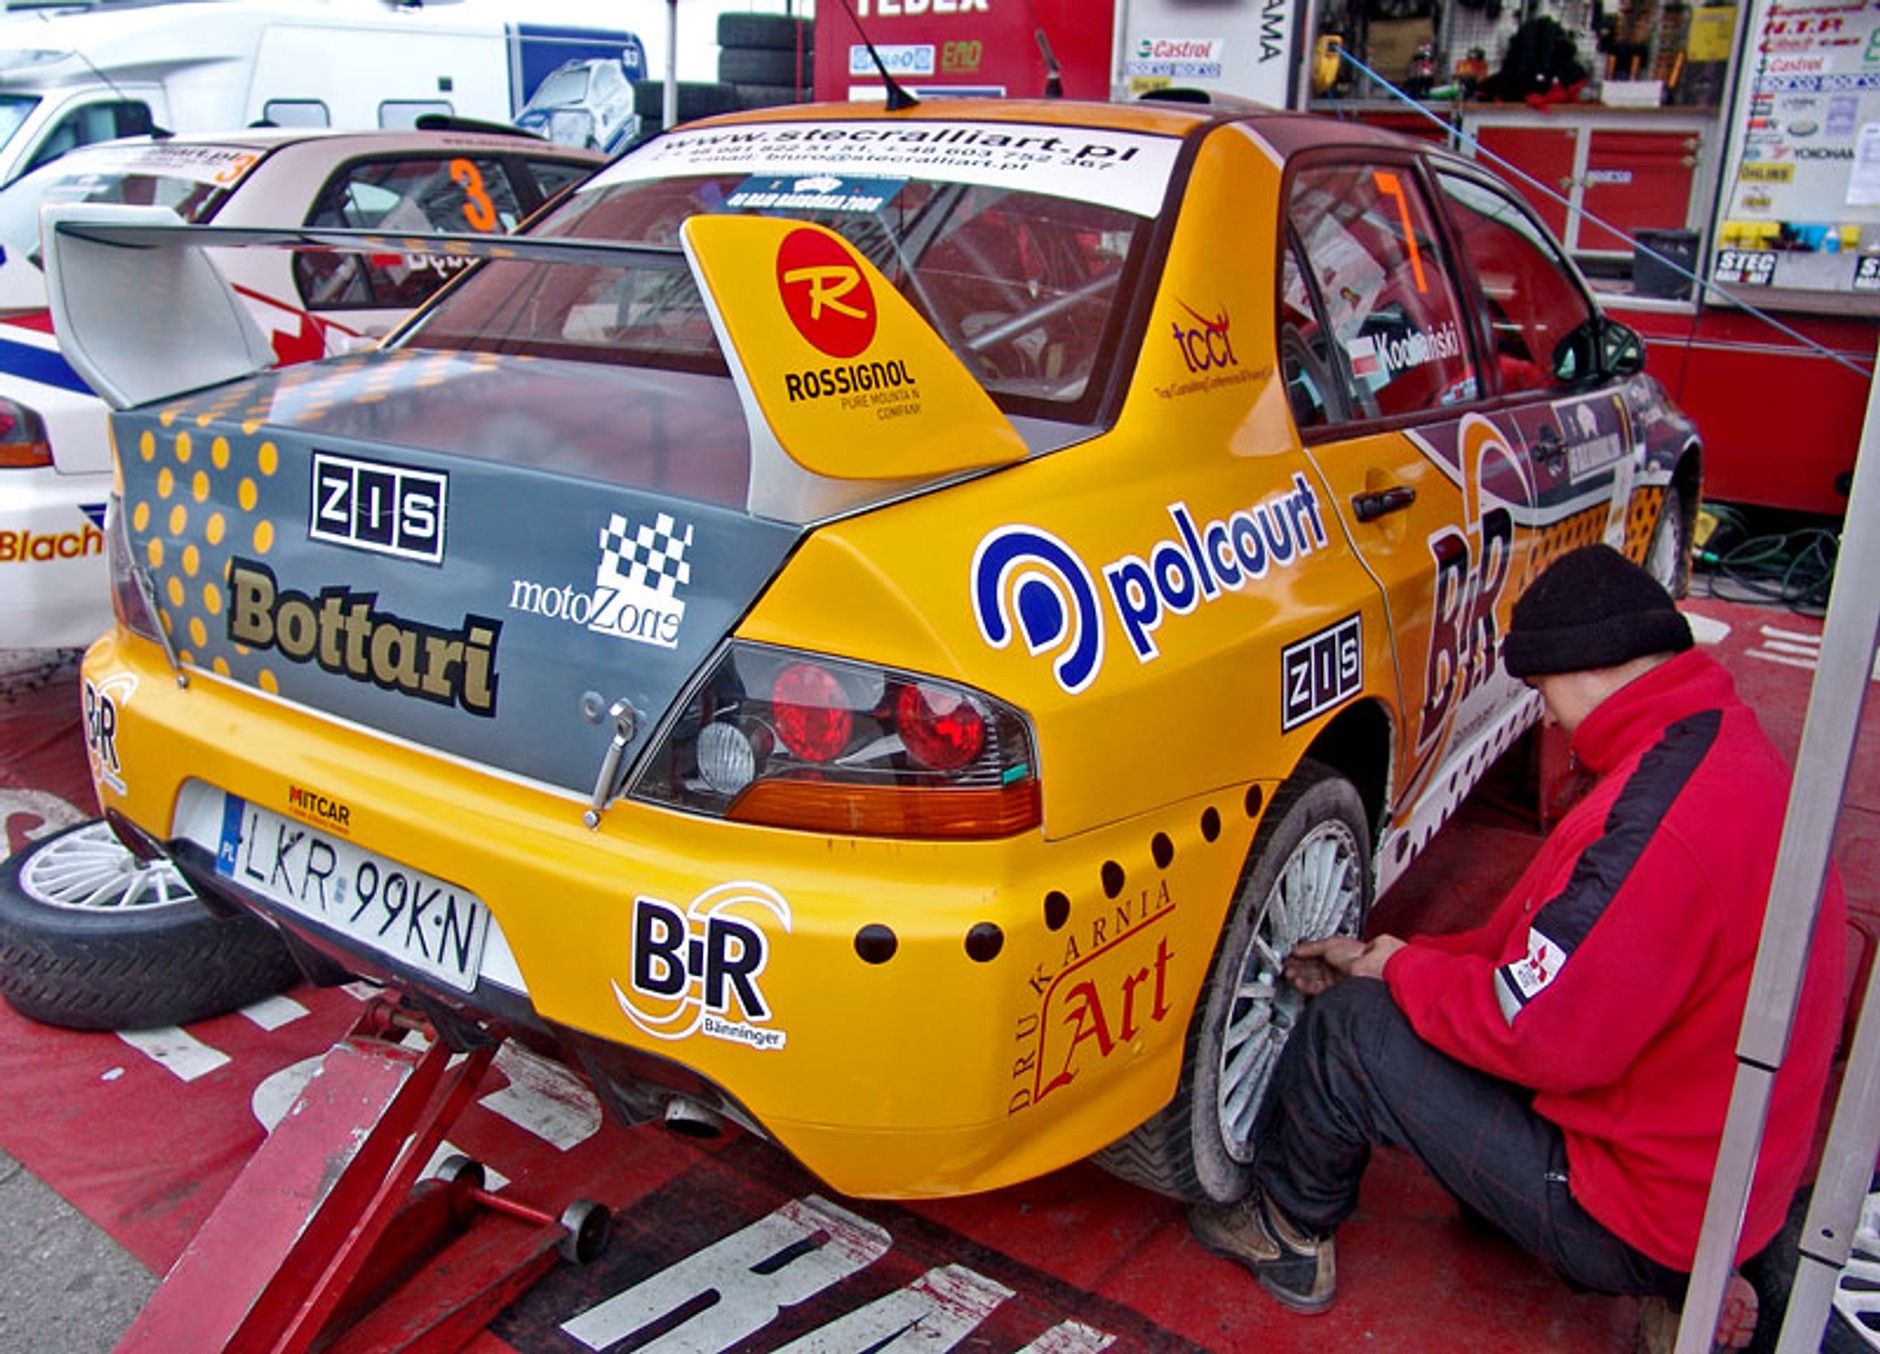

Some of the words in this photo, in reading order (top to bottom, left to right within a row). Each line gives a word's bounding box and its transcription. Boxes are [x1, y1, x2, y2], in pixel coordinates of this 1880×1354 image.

[1154, 40, 1212, 58] Castrol
[214, 153, 257, 183] 3
[664, 128, 1140, 161] www.stecralliart.pl
[451, 157, 497, 232] 3
[1720, 252, 1775, 272] STEC
[784, 264, 868, 321] R
[785, 359, 916, 402] ROSSIGNOL
[870, 388, 921, 406] MOUNTAN
[319, 475, 438, 539] ZIS
[1106, 474, 1326, 658] polcourt
[230, 560, 500, 714] Bottari
[508, 579, 682, 644] motoZone
[1288, 634, 1359, 722] ZIS
[290, 786, 349, 826] MITCAR
[245, 813, 337, 912] LKR
[350, 860, 476, 973] 99KN
[1008, 879, 1171, 1116] DRUKARNIA
[1042, 935, 1176, 1090] Art
[704, 1017, 781, 1046] Bänninger
